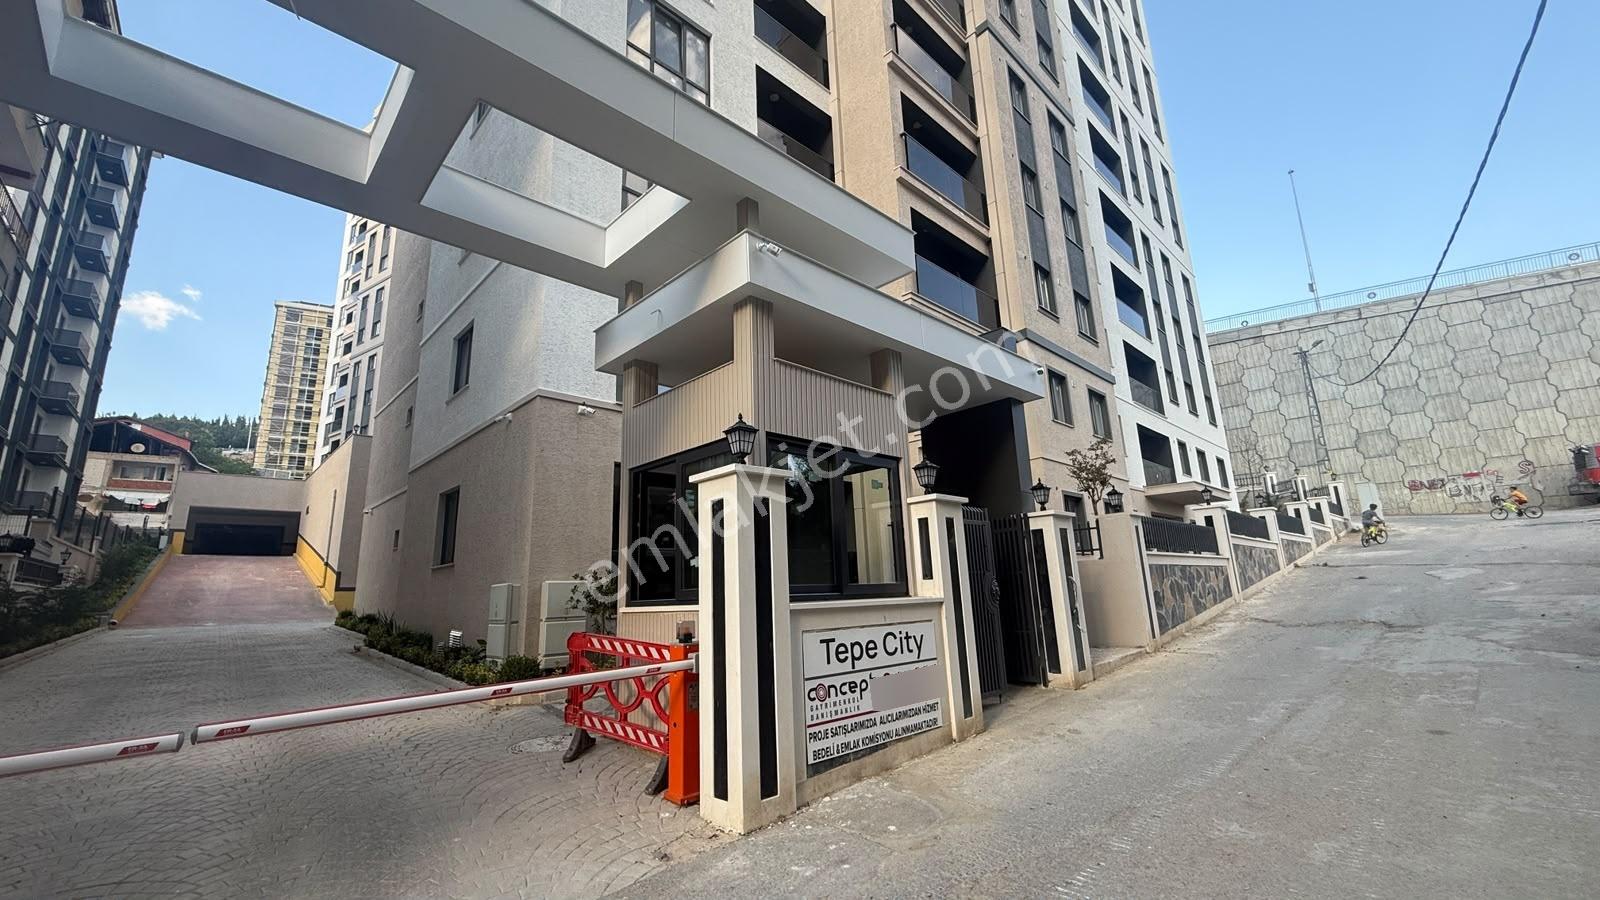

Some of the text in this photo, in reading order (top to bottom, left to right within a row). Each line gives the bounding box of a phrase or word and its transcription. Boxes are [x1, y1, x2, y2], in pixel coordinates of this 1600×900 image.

[820, 631, 924, 669] Tepe City
[808, 728, 830, 744] PROJE
[830, 717, 877, 738] SATIŞLARIMIZDA
[812, 742, 836, 762] BEDELİ
[841, 737, 861, 754] EMLAK
[861, 730, 894, 748] KOMİSYONU
